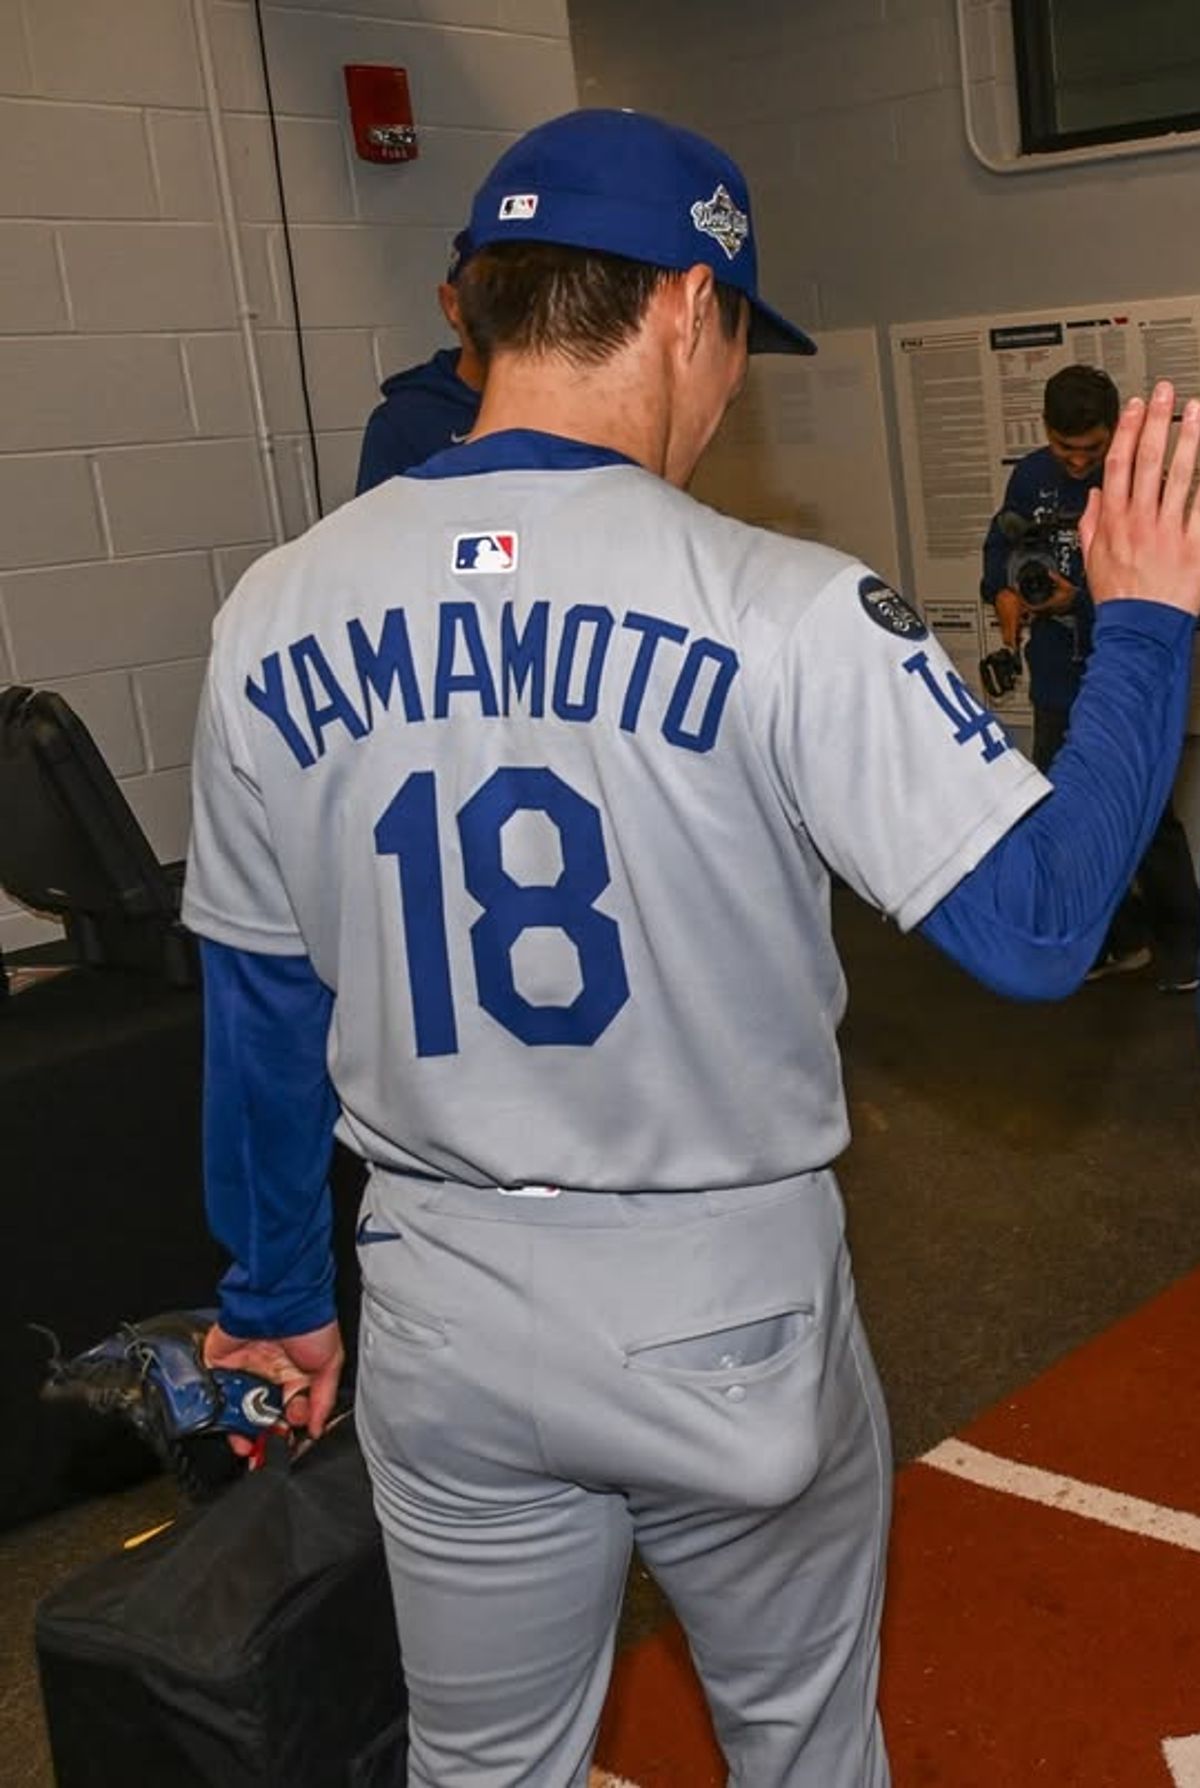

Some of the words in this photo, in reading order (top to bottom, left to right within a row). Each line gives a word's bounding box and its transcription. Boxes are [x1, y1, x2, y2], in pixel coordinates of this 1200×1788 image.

[245, 600, 740, 769] YAMAMOTO
[902, 650, 1013, 764] LA
[373, 766, 630, 1058] 18
